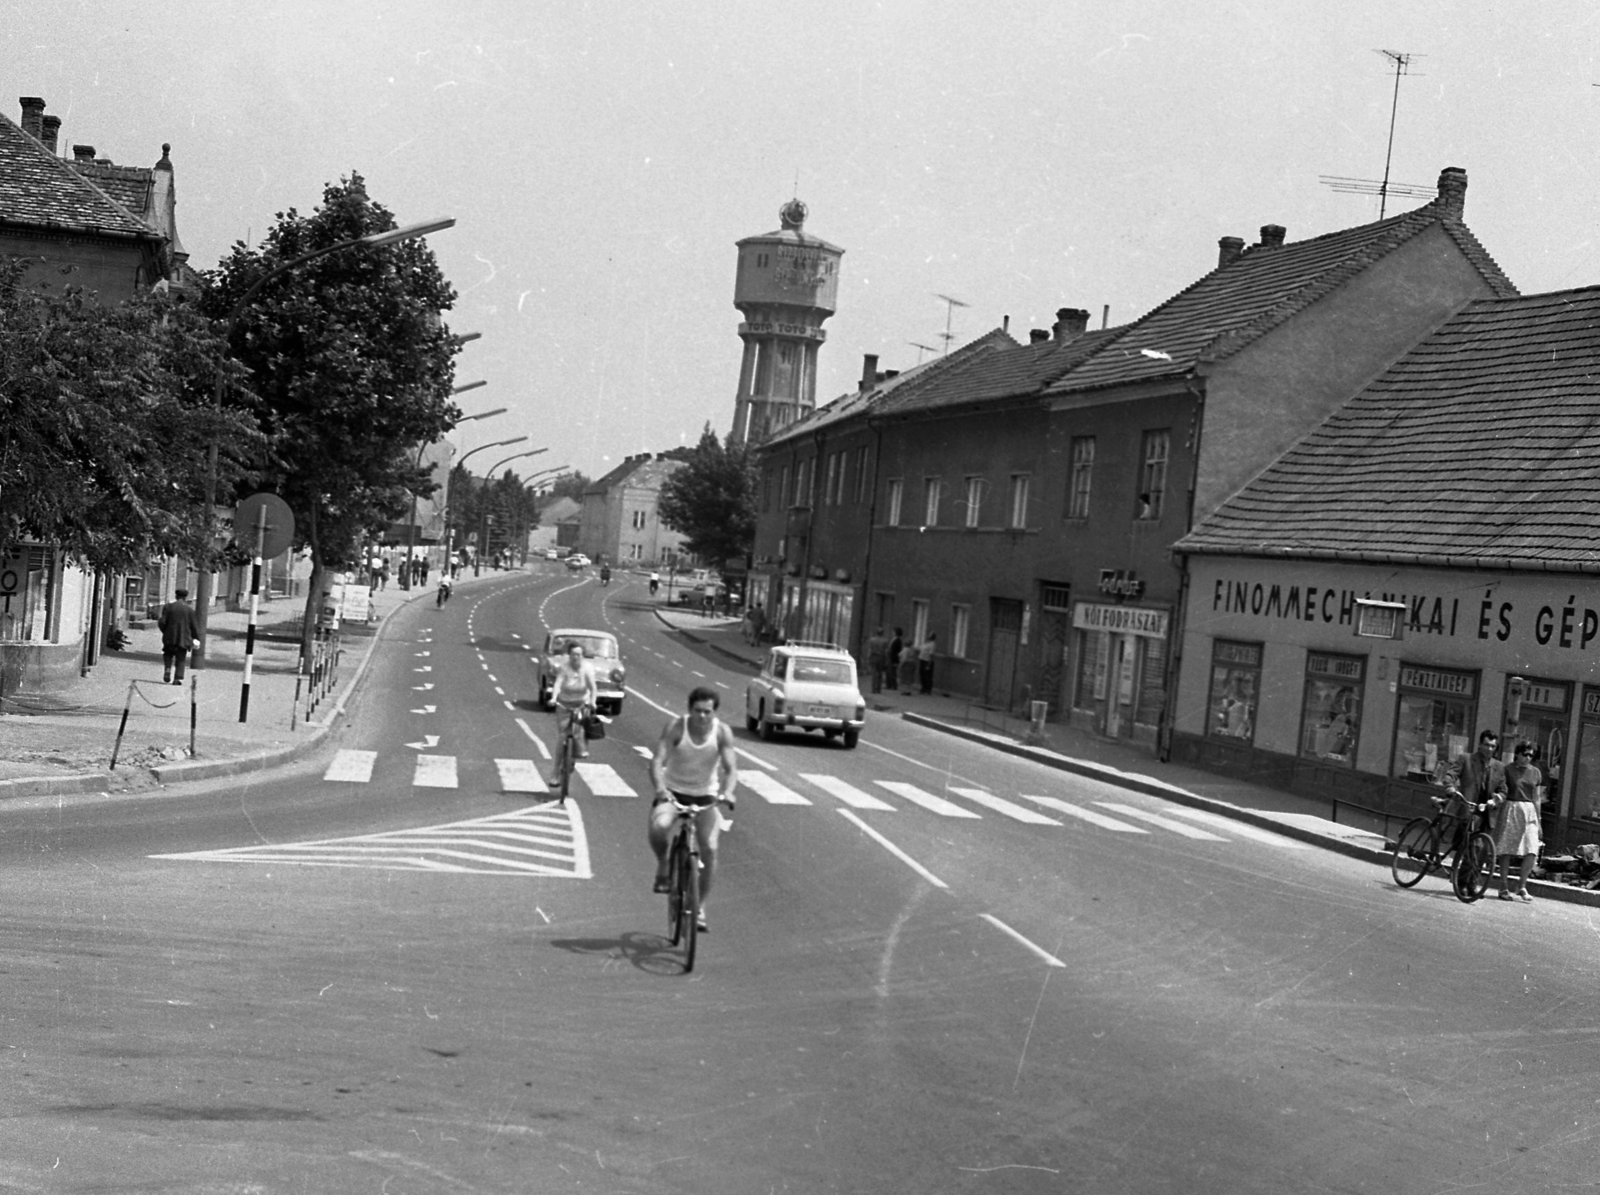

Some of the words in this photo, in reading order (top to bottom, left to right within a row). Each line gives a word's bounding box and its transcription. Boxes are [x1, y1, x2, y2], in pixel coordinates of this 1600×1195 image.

[778, 323, 807, 336] TOTO
[1213, 579, 1459, 636] FINOMMECHKAI
[1477, 589, 1513, 642] ÉS
[1535, 594, 1599, 650] GÉP
[1587, 693, 1600, 713] SZ
